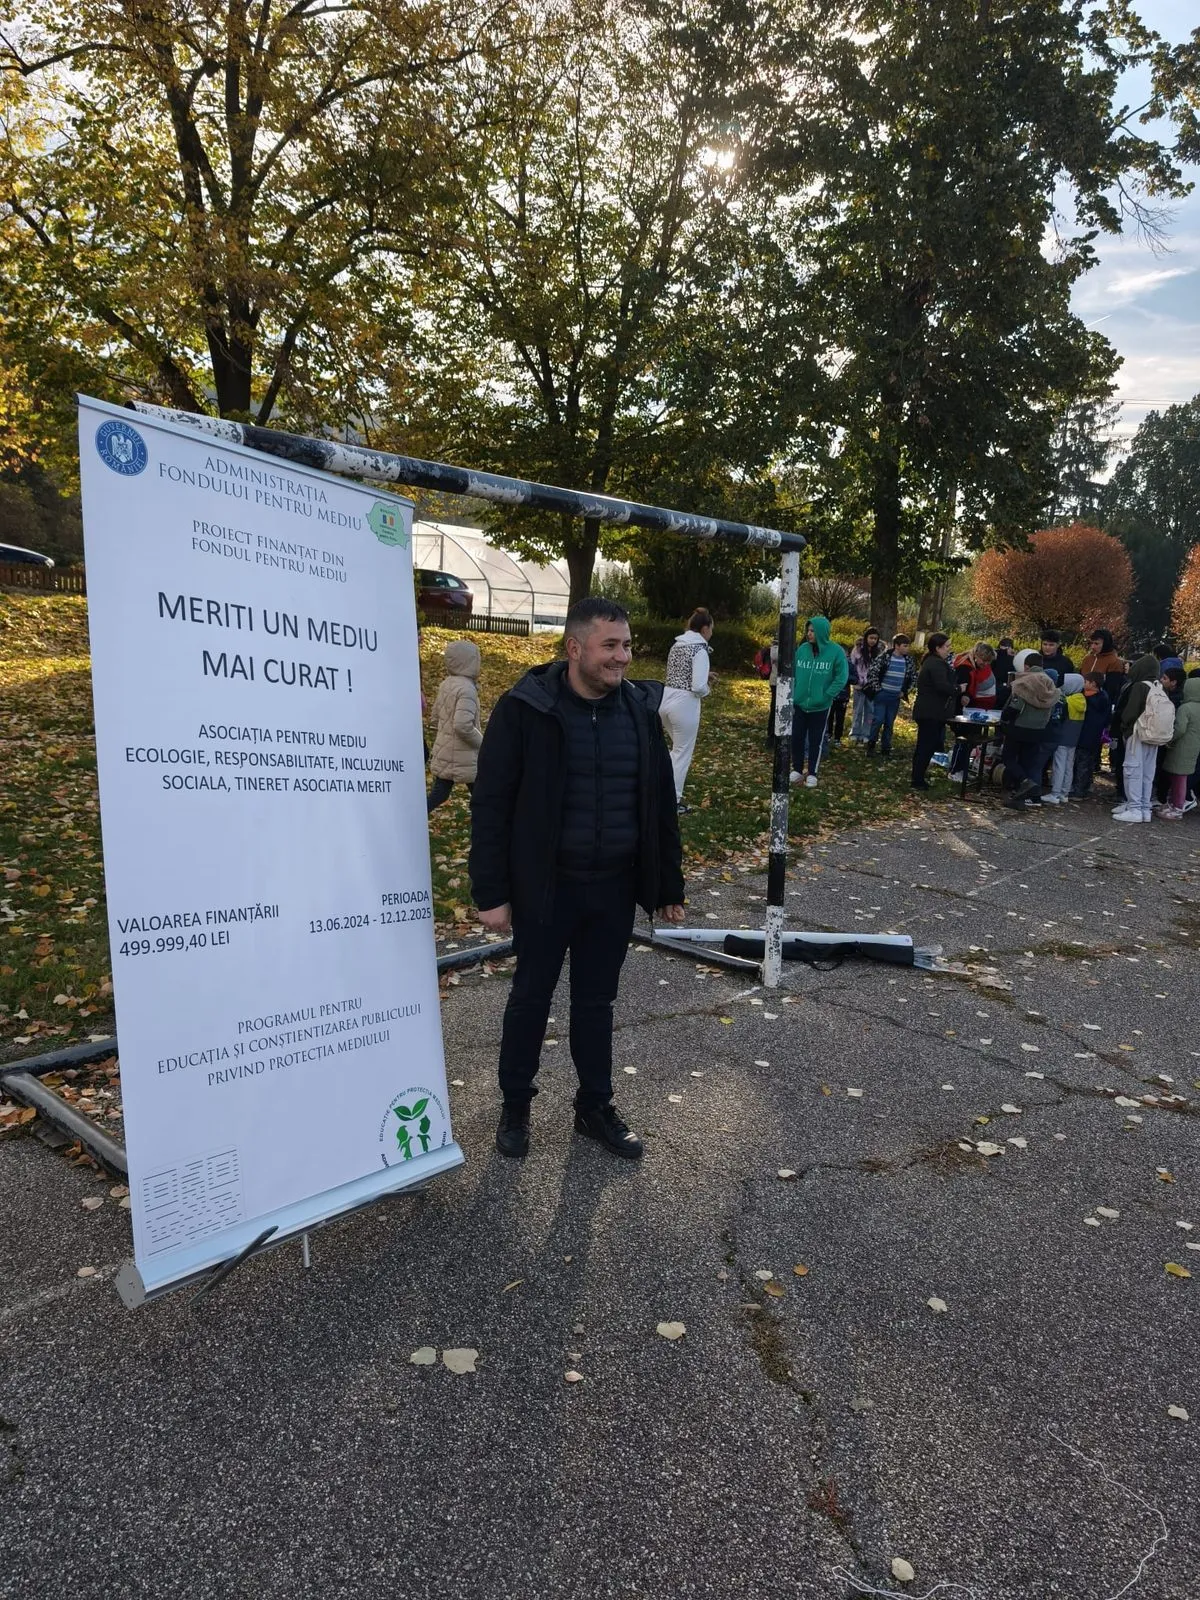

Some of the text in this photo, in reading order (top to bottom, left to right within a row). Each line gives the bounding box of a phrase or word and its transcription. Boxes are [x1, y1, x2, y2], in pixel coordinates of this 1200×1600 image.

[159, 463, 361, 531] FONDULUI PENTRU MEDIU
[192, 537, 347, 583] FONDUL PENTRU MEDIU
[193, 520, 344, 567] PROIECT FINANȚAT DIN
[158, 592, 377, 652] MERITI UN MEDIU
[202, 650, 352, 693] MAI CURAT !
[198, 724, 367, 749] ASOCIAȚIA PENTRU MEDIU
[126, 747, 210, 767] ECOLOGIE,
[341, 757, 405, 772] INCLUZIUNE
[162, 775, 392, 793] SOCIALA, TINERET ASOCIATIA MERIT
[381, 890, 430, 906] PERIOADA
[117, 904, 279, 934] VALOAREA FINANȚĂRII
[309, 914, 370, 934] 13.06.2024
[380, 907, 432, 925] 12.12.2025
[119, 930, 230, 956] 499.999,40 LEI
[238, 997, 362, 1034] PROGRAMUL PENTRU
[158, 1003, 421, 1074] EDUCAȚIA ȘI CONȘTIENTIZAREA PUBLICULUI
[207, 1029, 390, 1086] PRIVIND PROTECȚIA MEDIULUI
